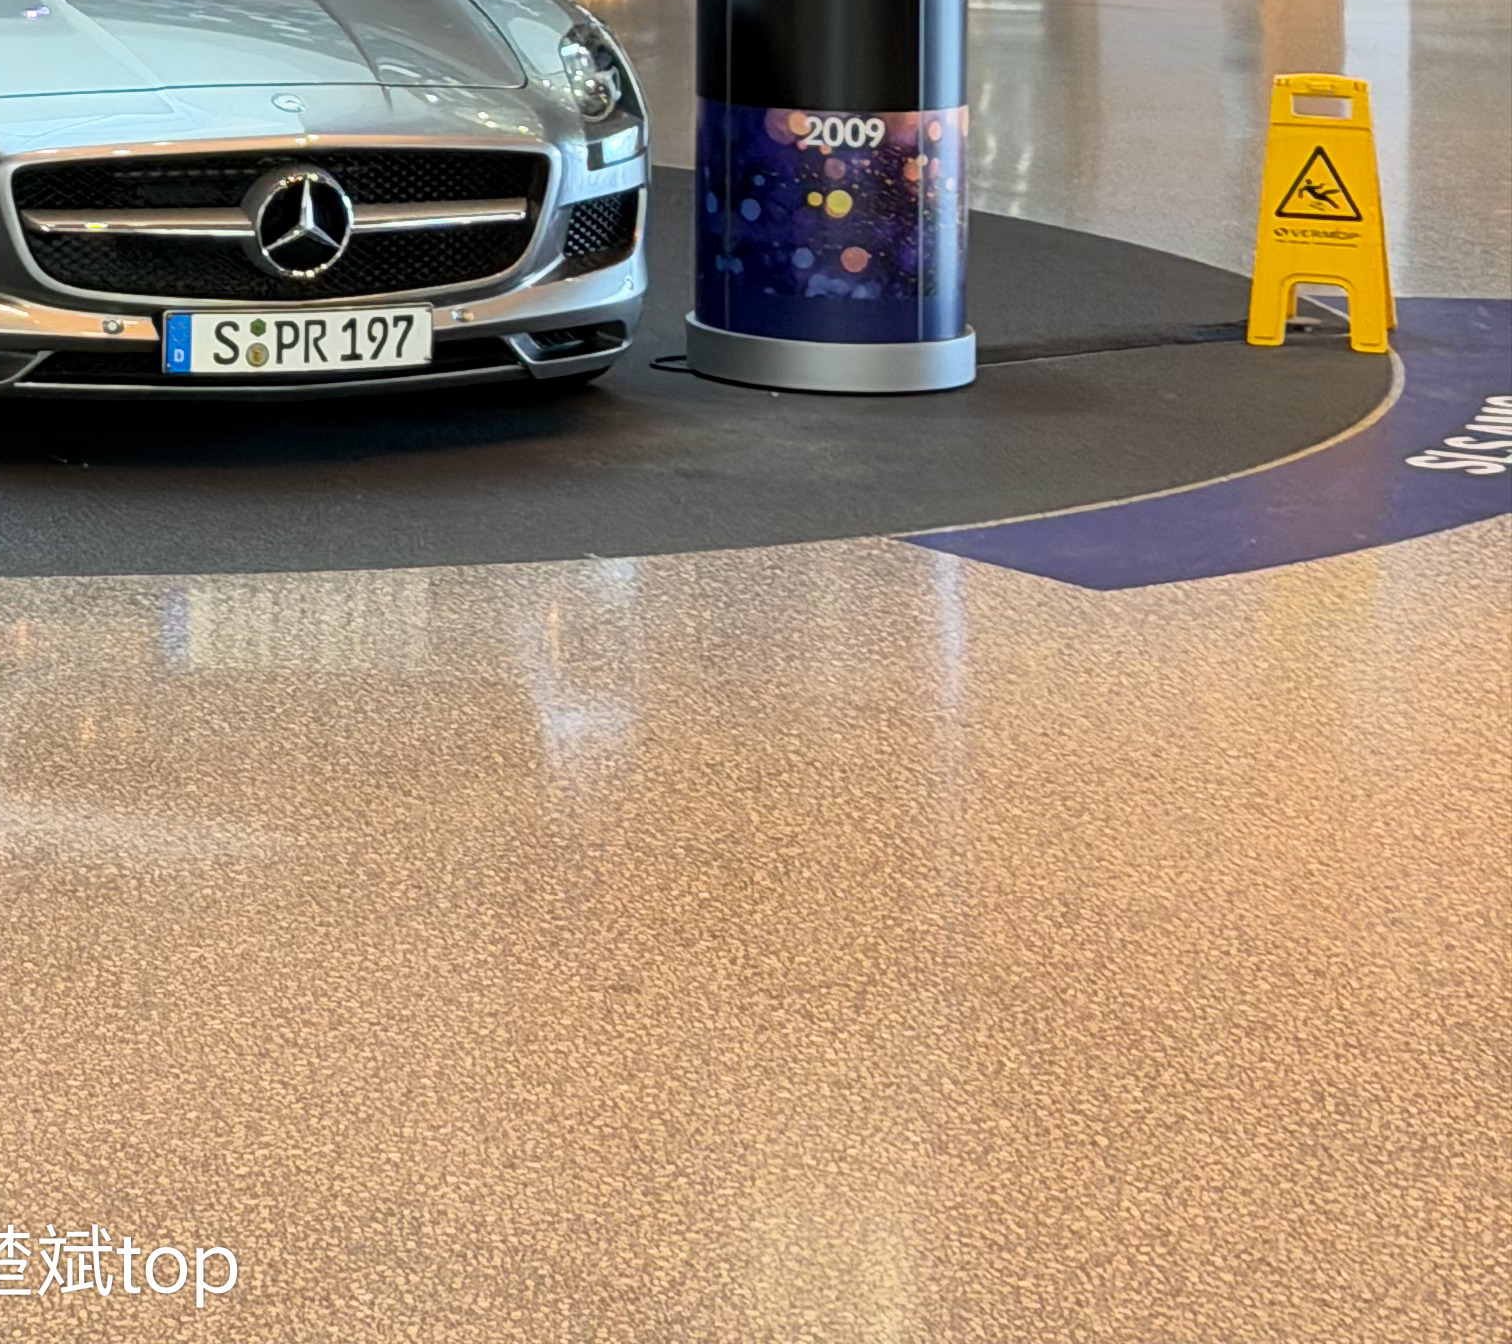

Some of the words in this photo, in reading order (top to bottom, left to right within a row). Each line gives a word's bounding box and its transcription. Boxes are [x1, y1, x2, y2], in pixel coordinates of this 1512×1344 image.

[801, 116, 886, 148] 2009
[213, 321, 240, 365] S
[274, 319, 328, 364] PR
[340, 314, 414, 361] 197
